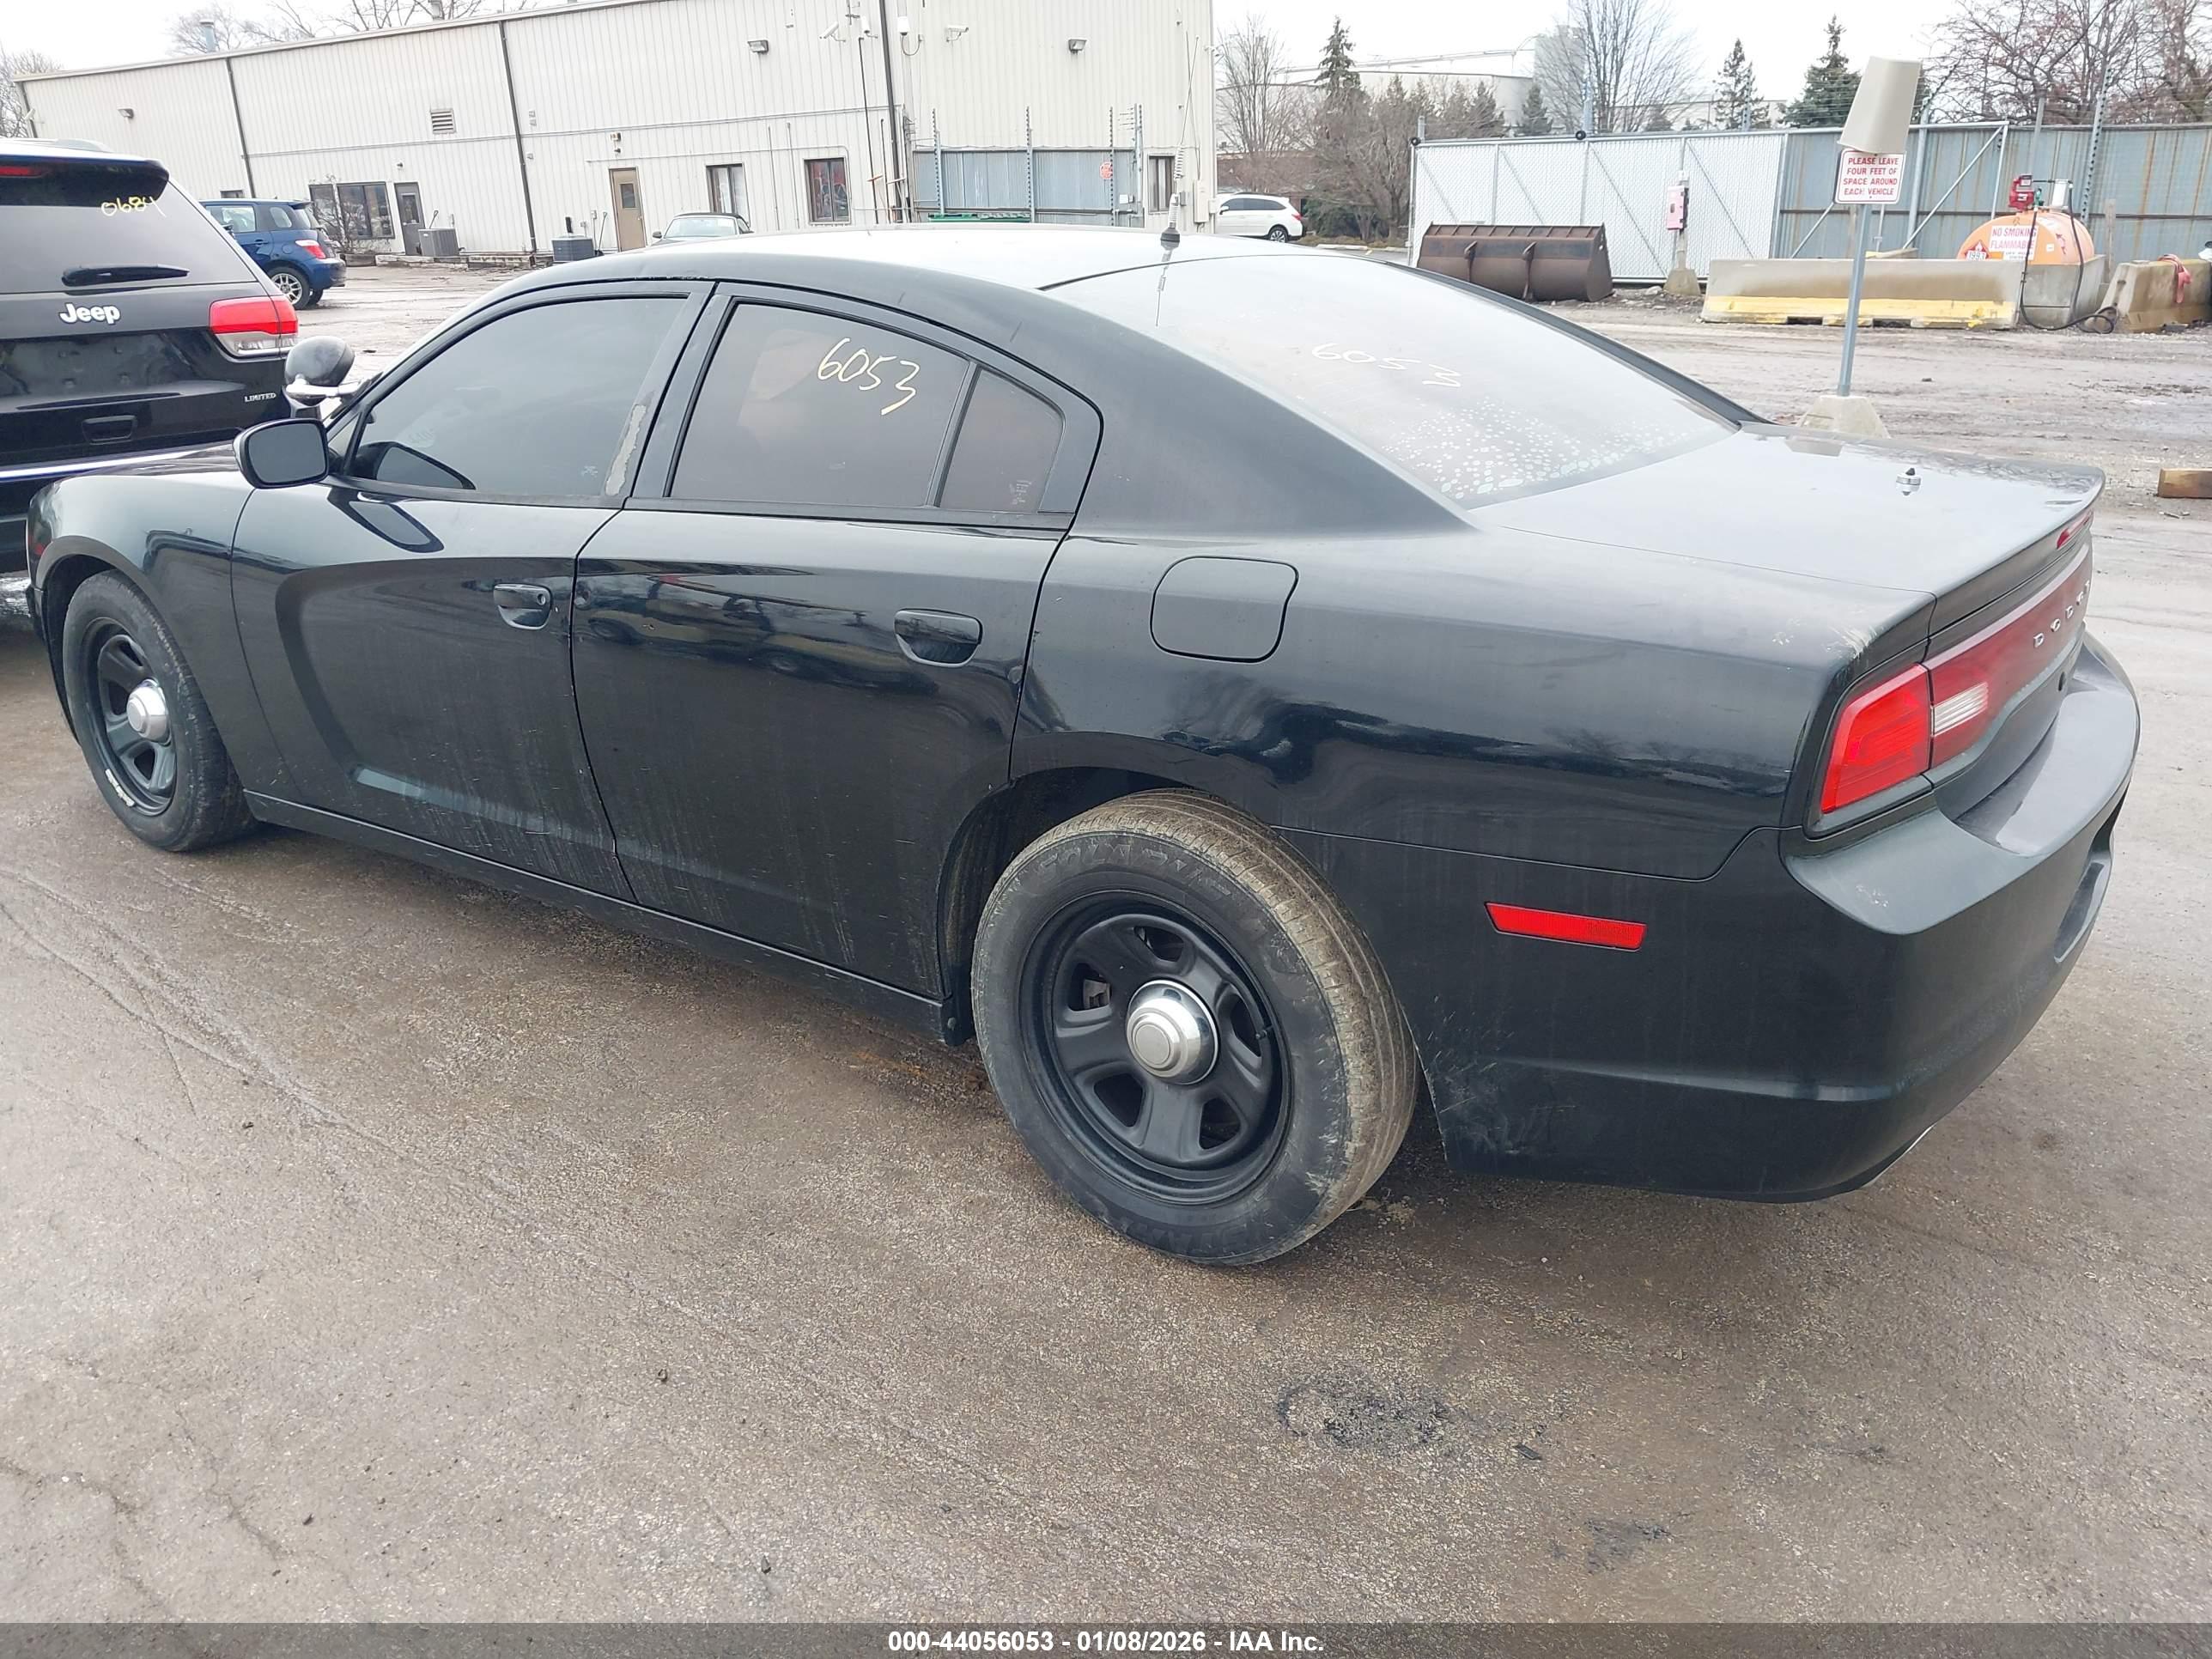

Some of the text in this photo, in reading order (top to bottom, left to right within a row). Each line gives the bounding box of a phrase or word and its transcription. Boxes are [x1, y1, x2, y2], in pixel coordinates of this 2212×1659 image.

[100, 196, 166, 217] 0684
[1992, 228, 2002, 236] NO
[1990, 240, 2034, 249] FLAMMABE
[59, 302, 120, 325] Jeep
[1312, 343, 1462, 387] 6053
[817, 337, 920, 416] 6053
[244, 392, 276, 402] LIMITED
